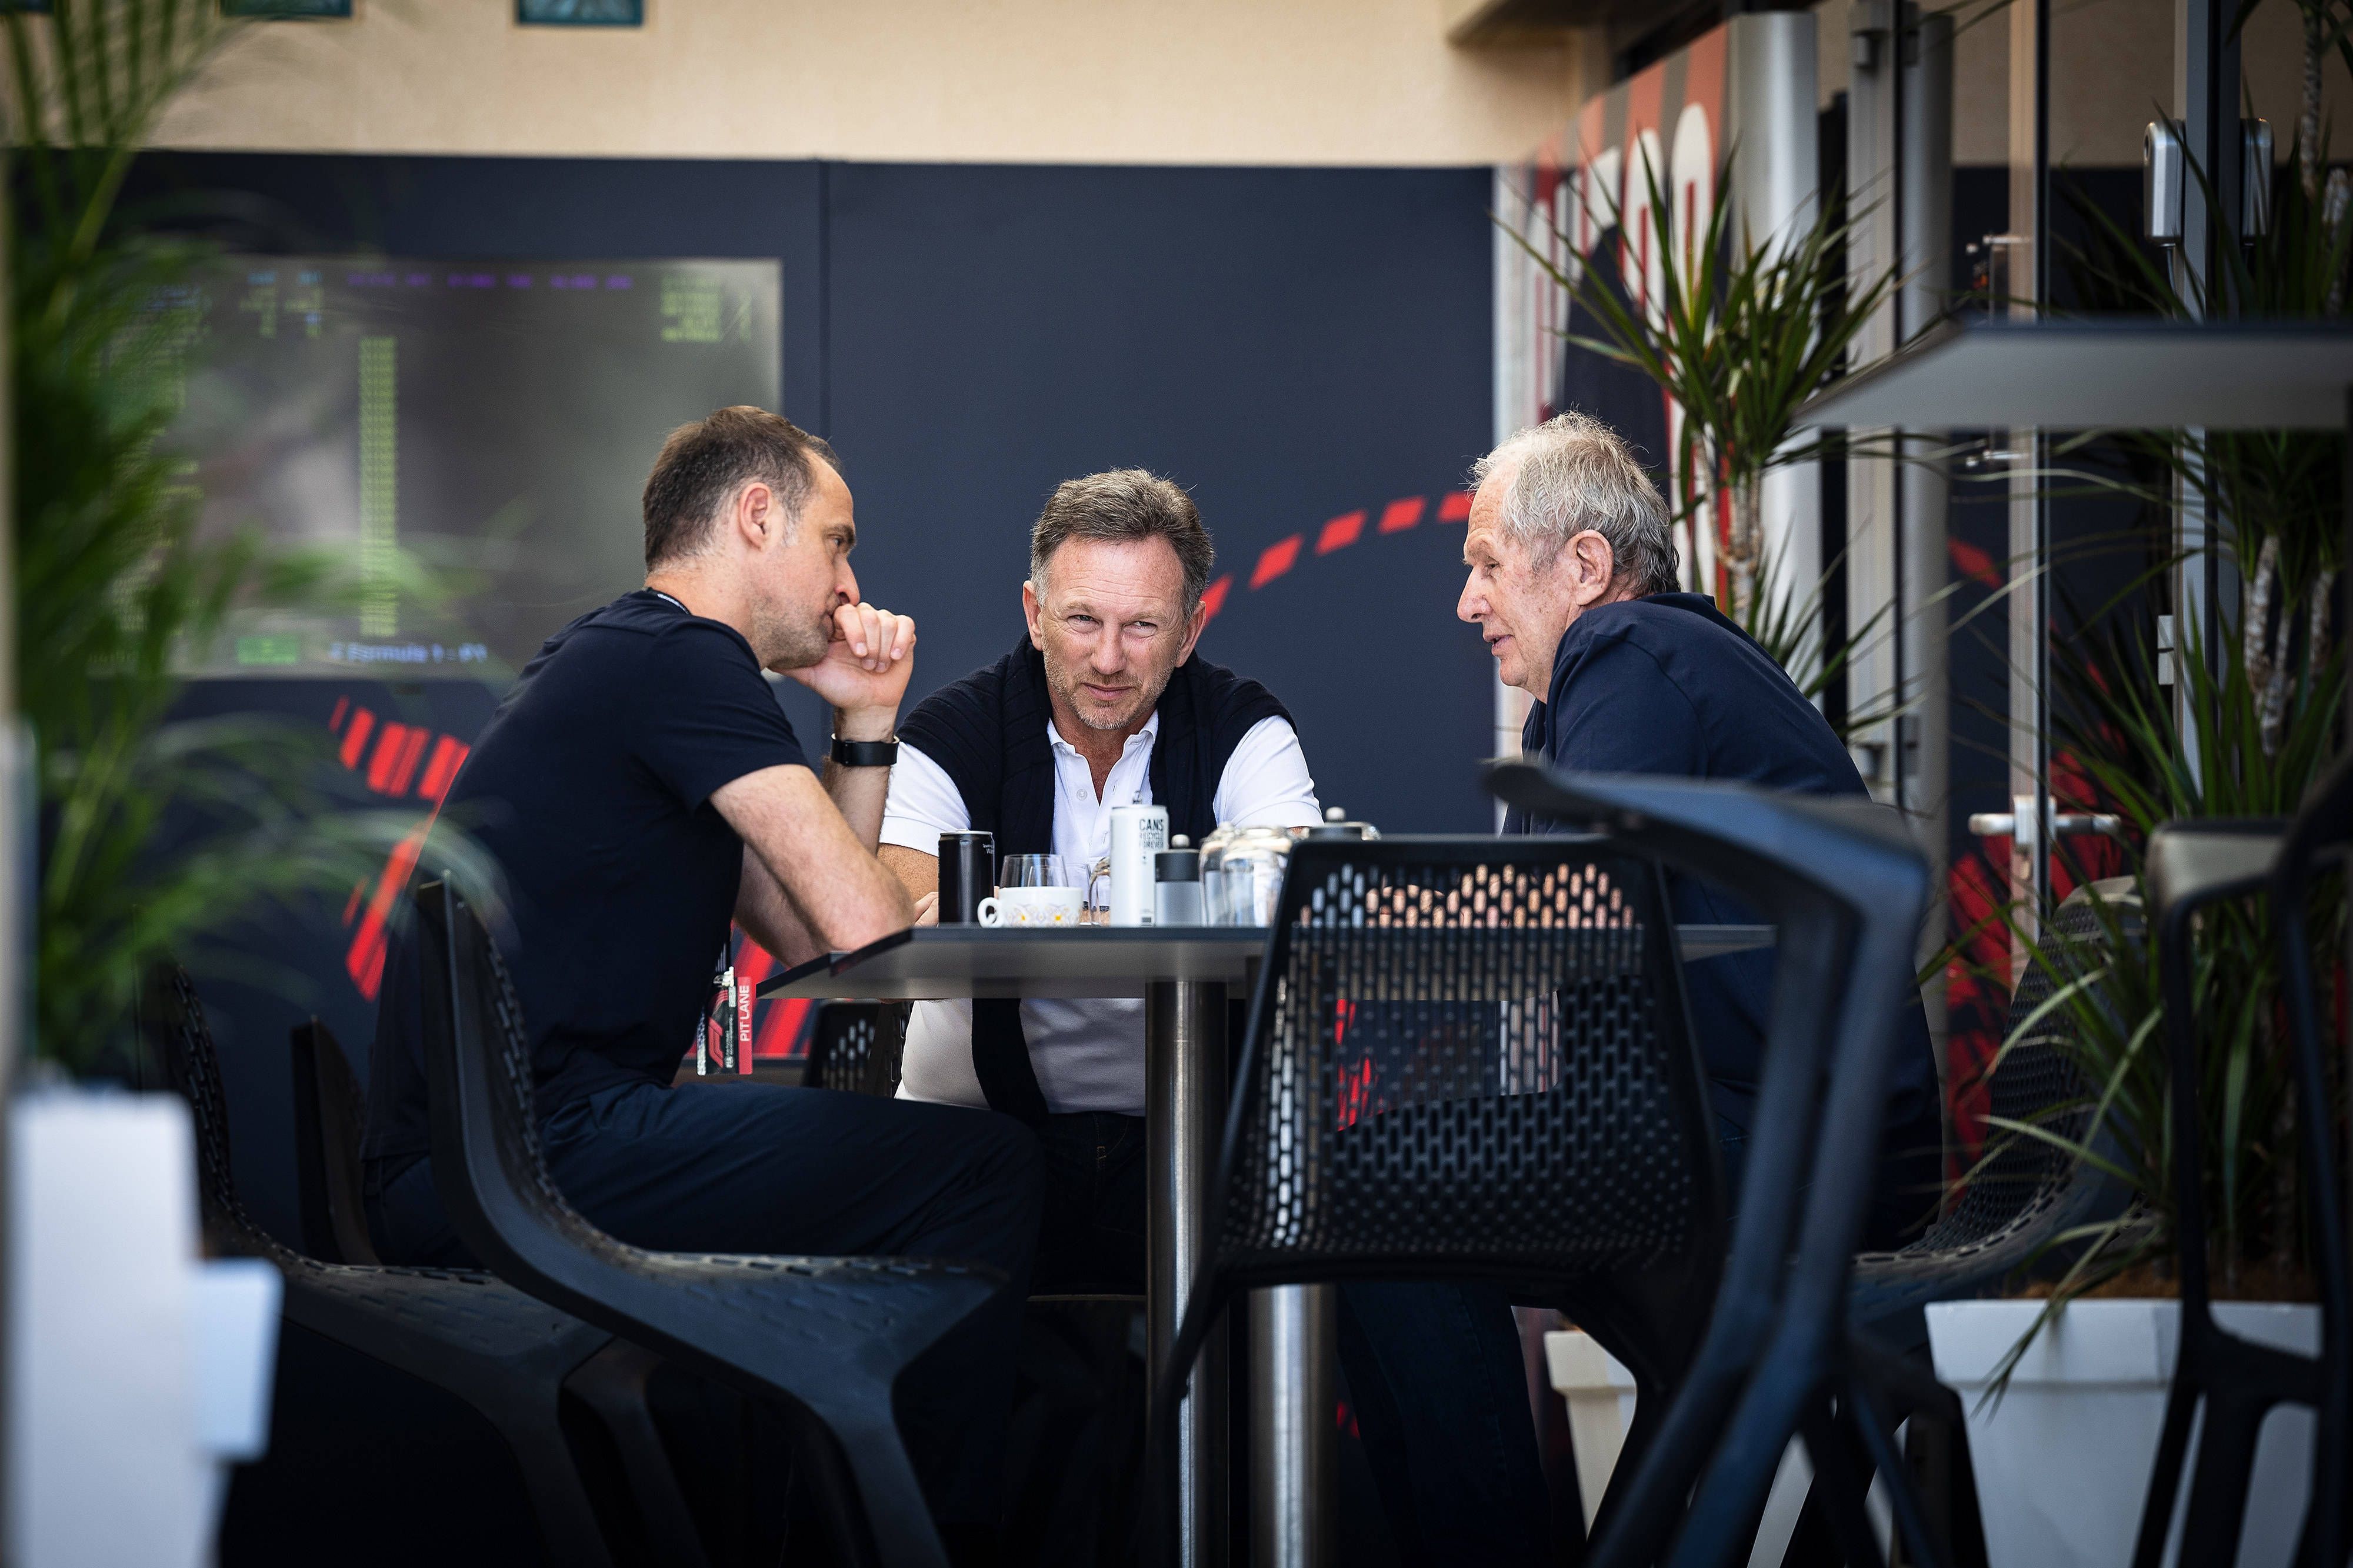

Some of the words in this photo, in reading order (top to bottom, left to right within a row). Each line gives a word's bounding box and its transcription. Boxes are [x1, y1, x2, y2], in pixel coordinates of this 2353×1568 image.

[1139, 819, 1164, 831] CANS
[739, 985, 751, 1020] LANE
[739, 1022, 751, 1042] PIT
